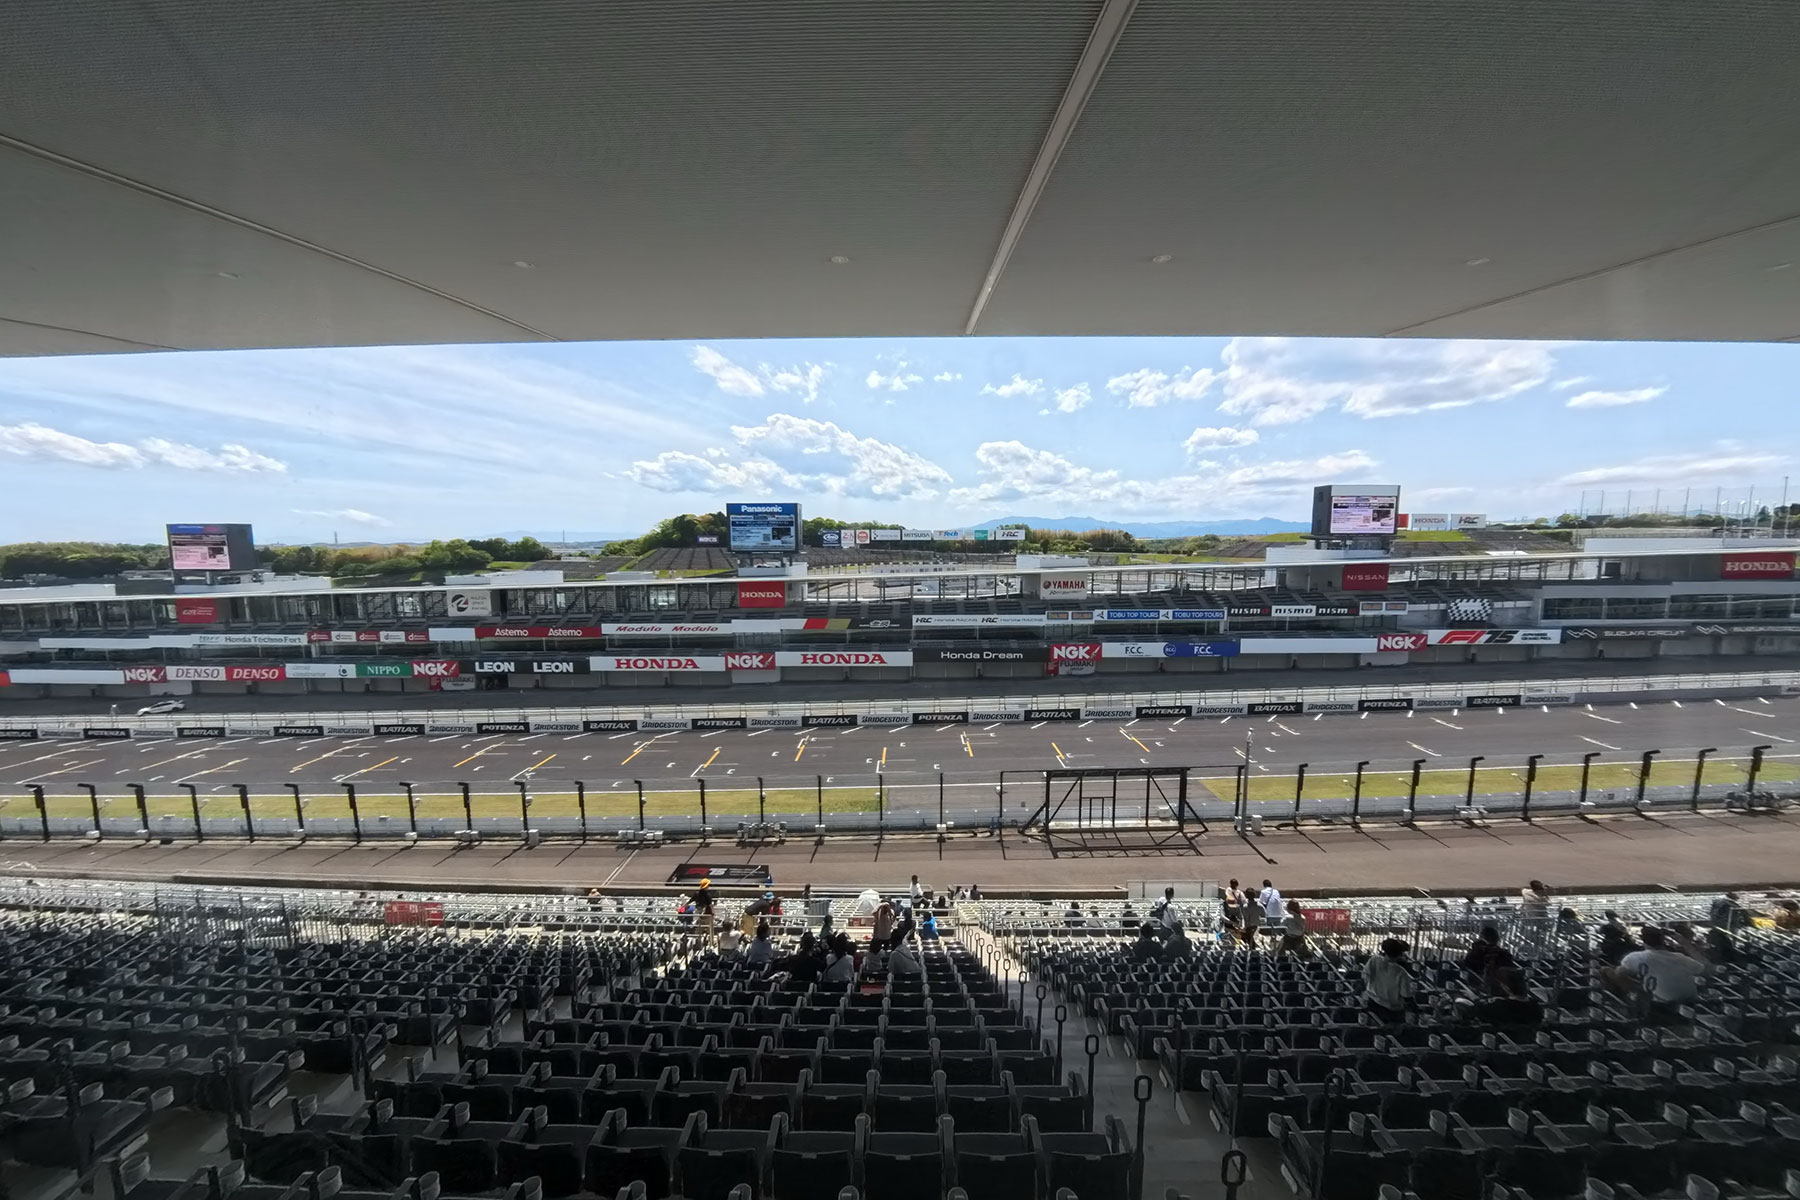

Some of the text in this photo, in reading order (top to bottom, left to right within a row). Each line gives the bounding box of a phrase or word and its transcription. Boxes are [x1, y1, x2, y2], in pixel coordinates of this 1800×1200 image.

[741, 505, 783, 513] Panasonic
[1725, 561, 1792, 571] HONDA
[1052, 580, 1086, 590] YAMAHA
[494, 627, 583, 637] Astemo Astemo
[225, 635, 253, 643] Honda
[1379, 637, 1416, 649] NGK
[1053, 646, 1090, 659] NGK
[615, 658, 700, 669] HONDA
[727, 654, 766, 669] NGK
[801, 653, 887, 665] HONDA
[367, 666, 400, 675] NIPPO
[413, 663, 447, 675] NGK
[475, 662, 573, 672] LEON LEON
[125, 668, 158, 682] NGK
[175, 668, 279, 679] DENSO DENSO
[1196, 706, 1244, 714] BRIDGESTONE
[1307, 703, 1354, 711] BRIDGESTONE
[972, 712, 1021, 720] BRIDGESTONE
[1085, 709, 1133, 717] BRIDGESTONE
[751, 718, 799, 726] BRIDGESTONE
[861, 715, 910, 724] BRIDGESTONE
[429, 725, 474, 733] BRIDGESTONE
[534, 723, 580, 731] BRIDGESTONE
[642, 721, 688, 729] BRIDGESTONE
